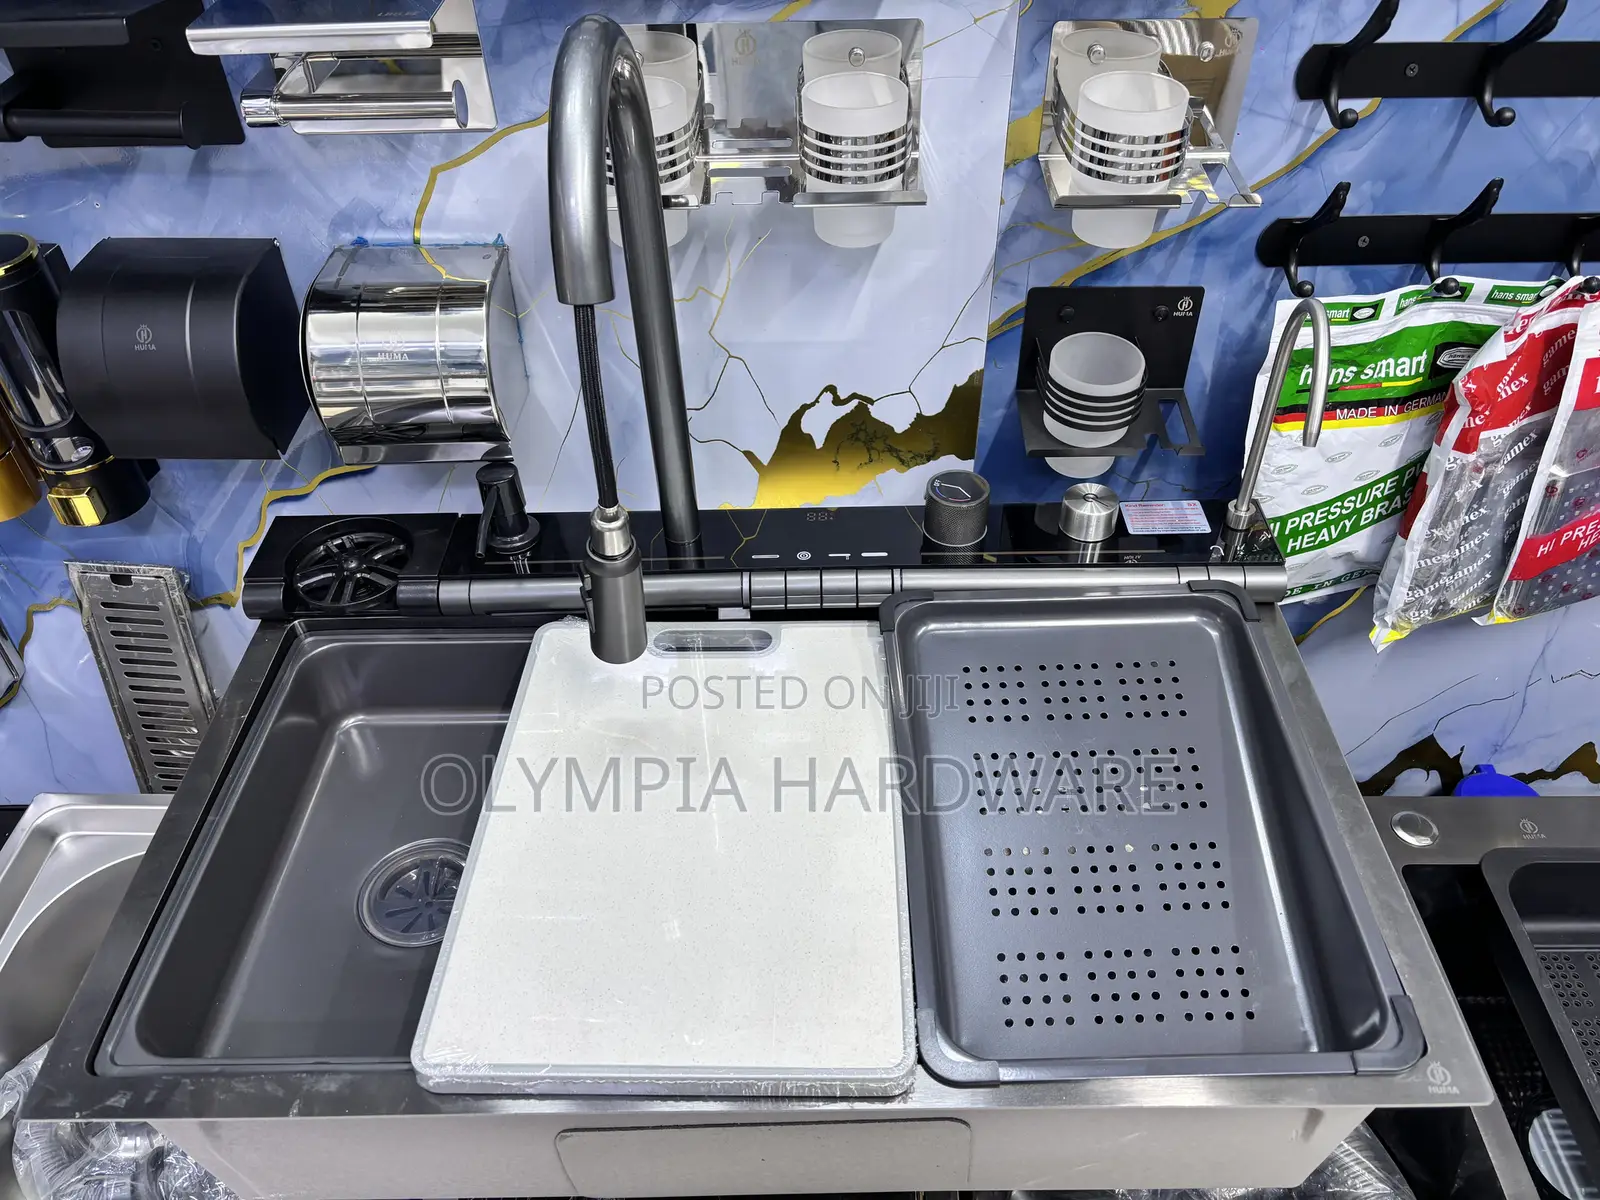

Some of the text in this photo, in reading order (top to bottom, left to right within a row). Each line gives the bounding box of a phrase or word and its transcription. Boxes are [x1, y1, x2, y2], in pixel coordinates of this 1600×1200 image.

[1490, 290, 1537, 302] hans smar
[1542, 328, 1576, 368] game
[1298, 349, 1428, 386] hns smart
[1543, 364, 1570, 396] gam
[1336, 391, 1446, 420] MADE IN GERMAN
[1496, 429, 1538, 474] gamex
[1285, 475, 1399, 535] PRESSURE
[1287, 514, 1358, 553] HEAVY
[1360, 489, 1413, 526] BRAS
[1537, 519, 1600, 558] HI PRE
[1577, 529, 1600, 551] HE
[1428, 1086, 1460, 1095] HUMA
